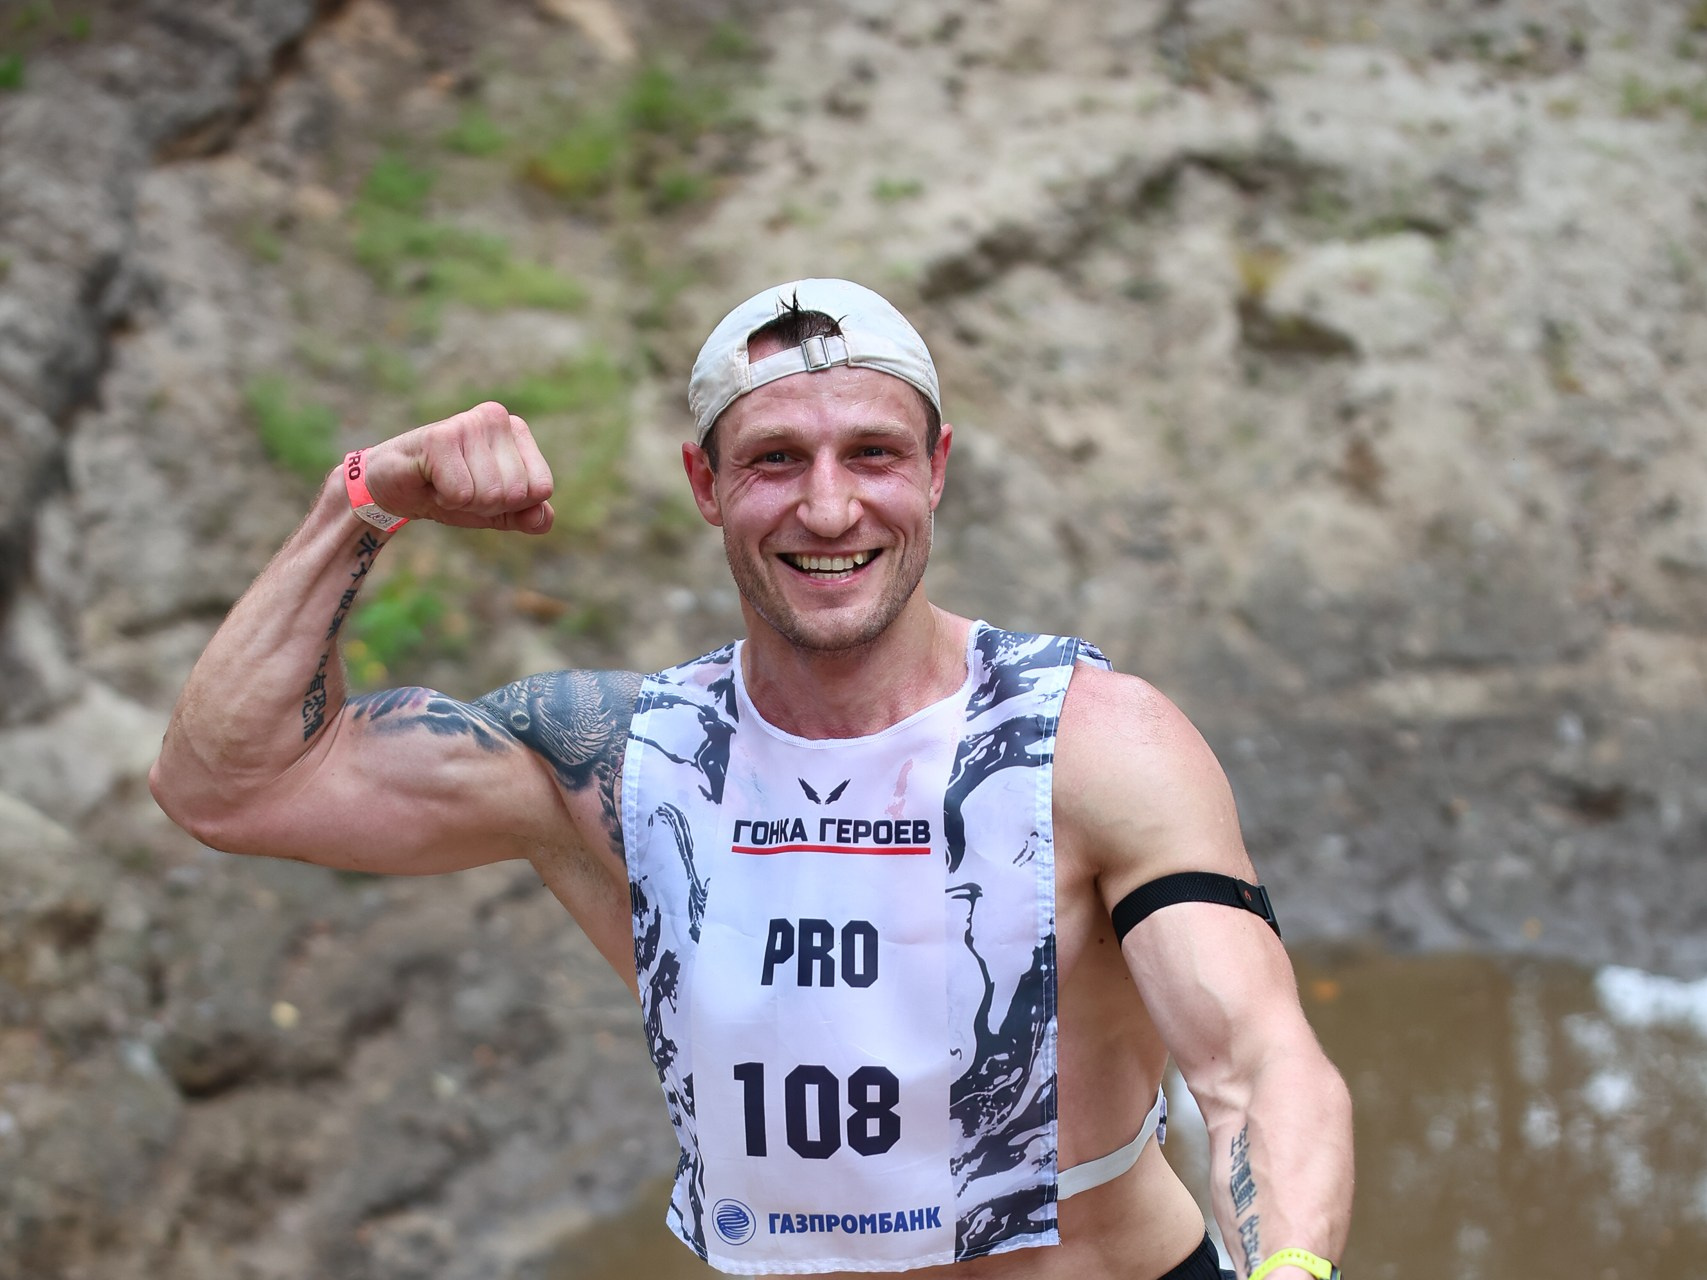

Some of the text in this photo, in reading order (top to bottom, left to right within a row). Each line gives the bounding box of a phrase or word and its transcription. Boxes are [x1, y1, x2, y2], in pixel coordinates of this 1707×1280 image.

[733, 818, 931, 845] ГОНКА ГЕРОЕВ
[761, 918, 878, 988] PRO
[734, 1062, 901, 1159] 108
[768, 1206, 942, 1235] ГАЗПРОМБАНК
